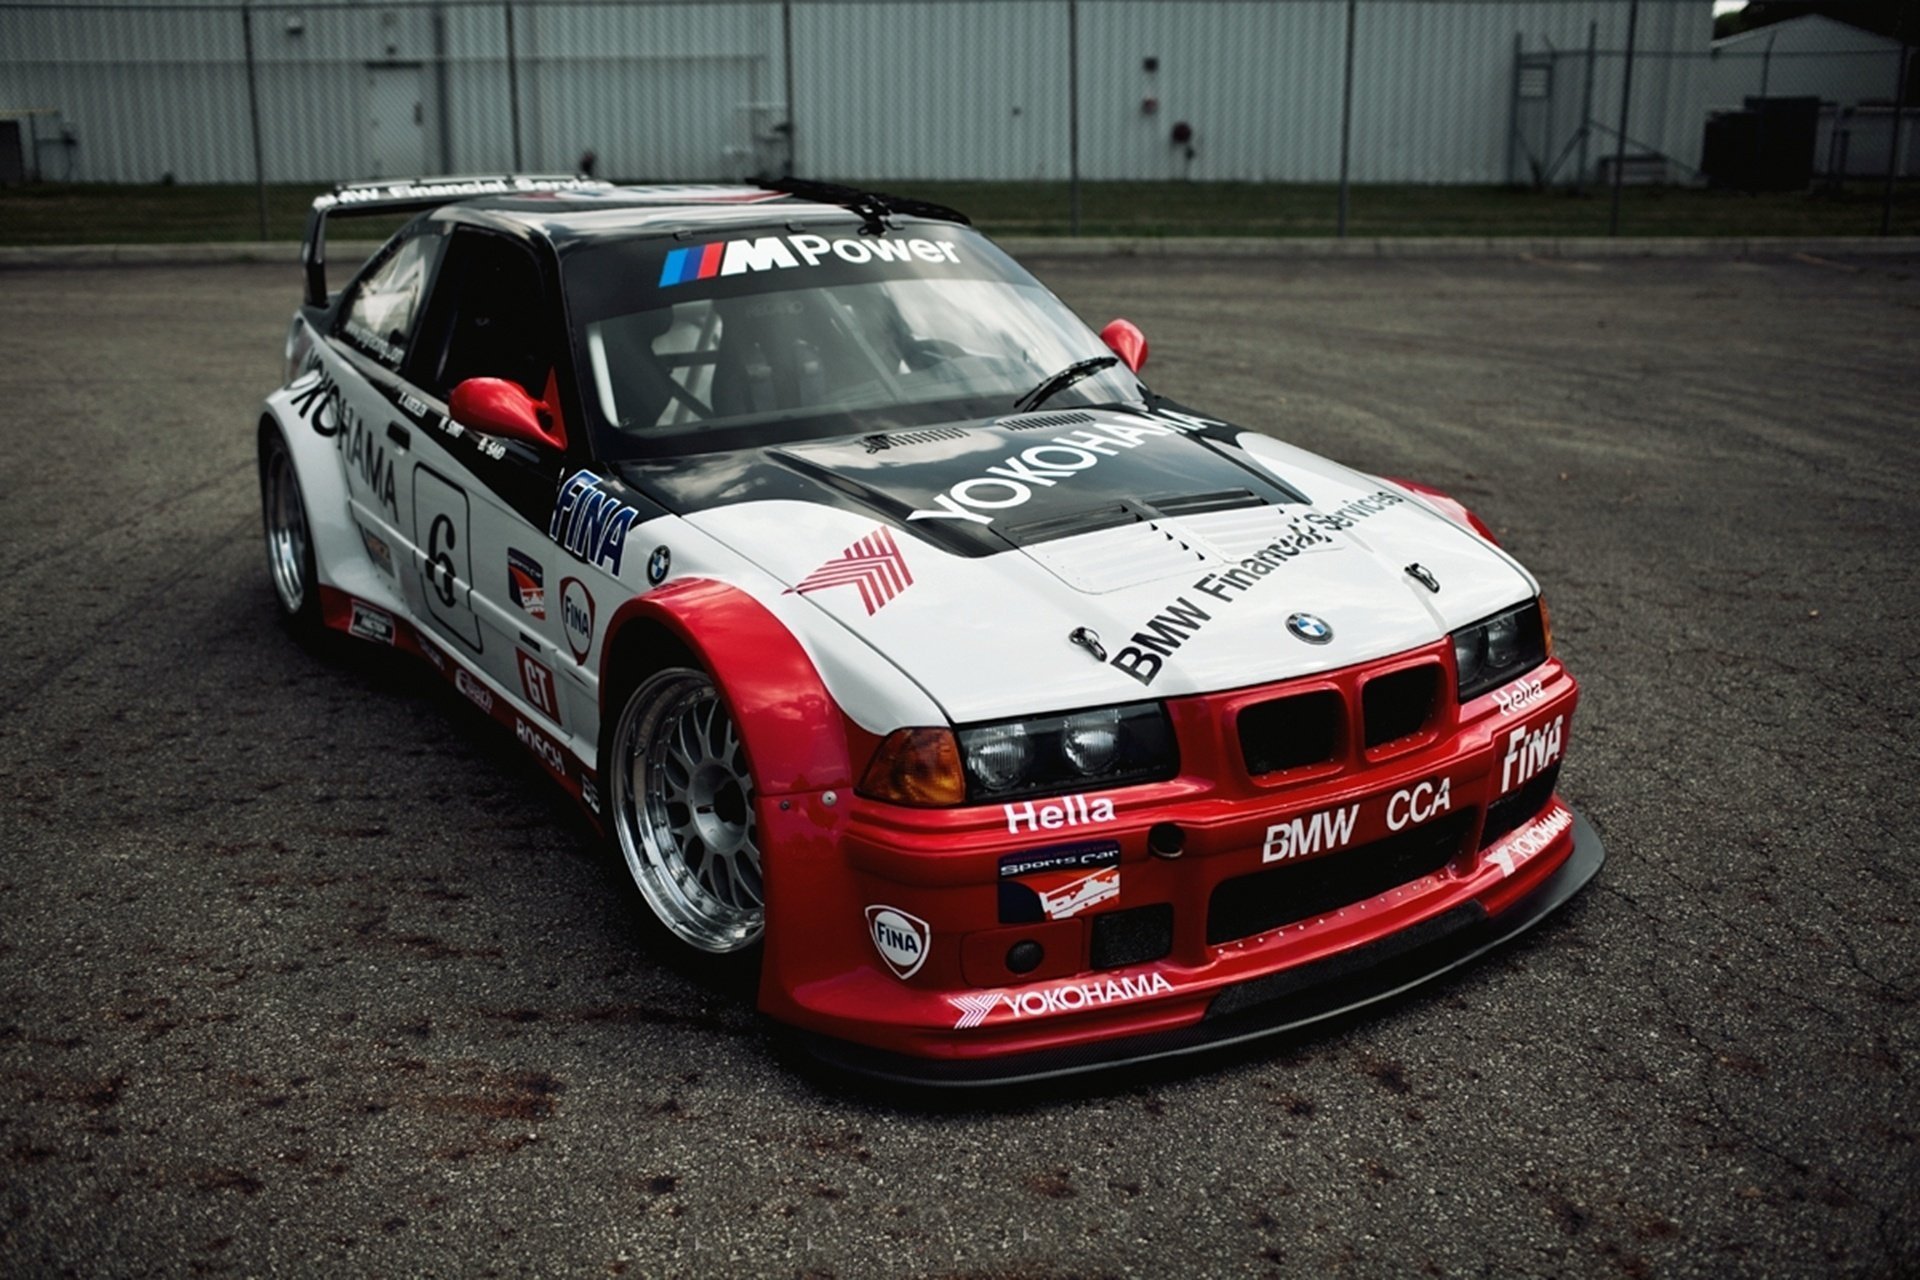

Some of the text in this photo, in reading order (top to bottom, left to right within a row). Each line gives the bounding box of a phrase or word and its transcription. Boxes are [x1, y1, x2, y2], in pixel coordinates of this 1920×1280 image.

[388, 179, 508, 198] Financial
[907, 408, 1228, 525] YOKOHAMA
[550, 468, 639, 578] FINA
[425, 513, 457, 608] 6
[1109, 491, 1404, 687] BMW Financial Services
[565, 595, 590, 640] FINA
[524, 658, 551, 714] GT
[1492, 678, 1547, 717] Hella
[516, 717, 566, 777] BOSCH
[1501, 714, 1564, 794] FINA
[1003, 794, 1118, 835] Hella
[1262, 777, 1451, 864] BMW CCA
[1508, 805, 1574, 859] YOKOHAMA
[1000, 856, 1077, 876] Sports
[1080, 849, 1119, 865] Car
[876, 921, 919, 954] FINA
[1003, 972, 1174, 1019] YOKOHAMA
